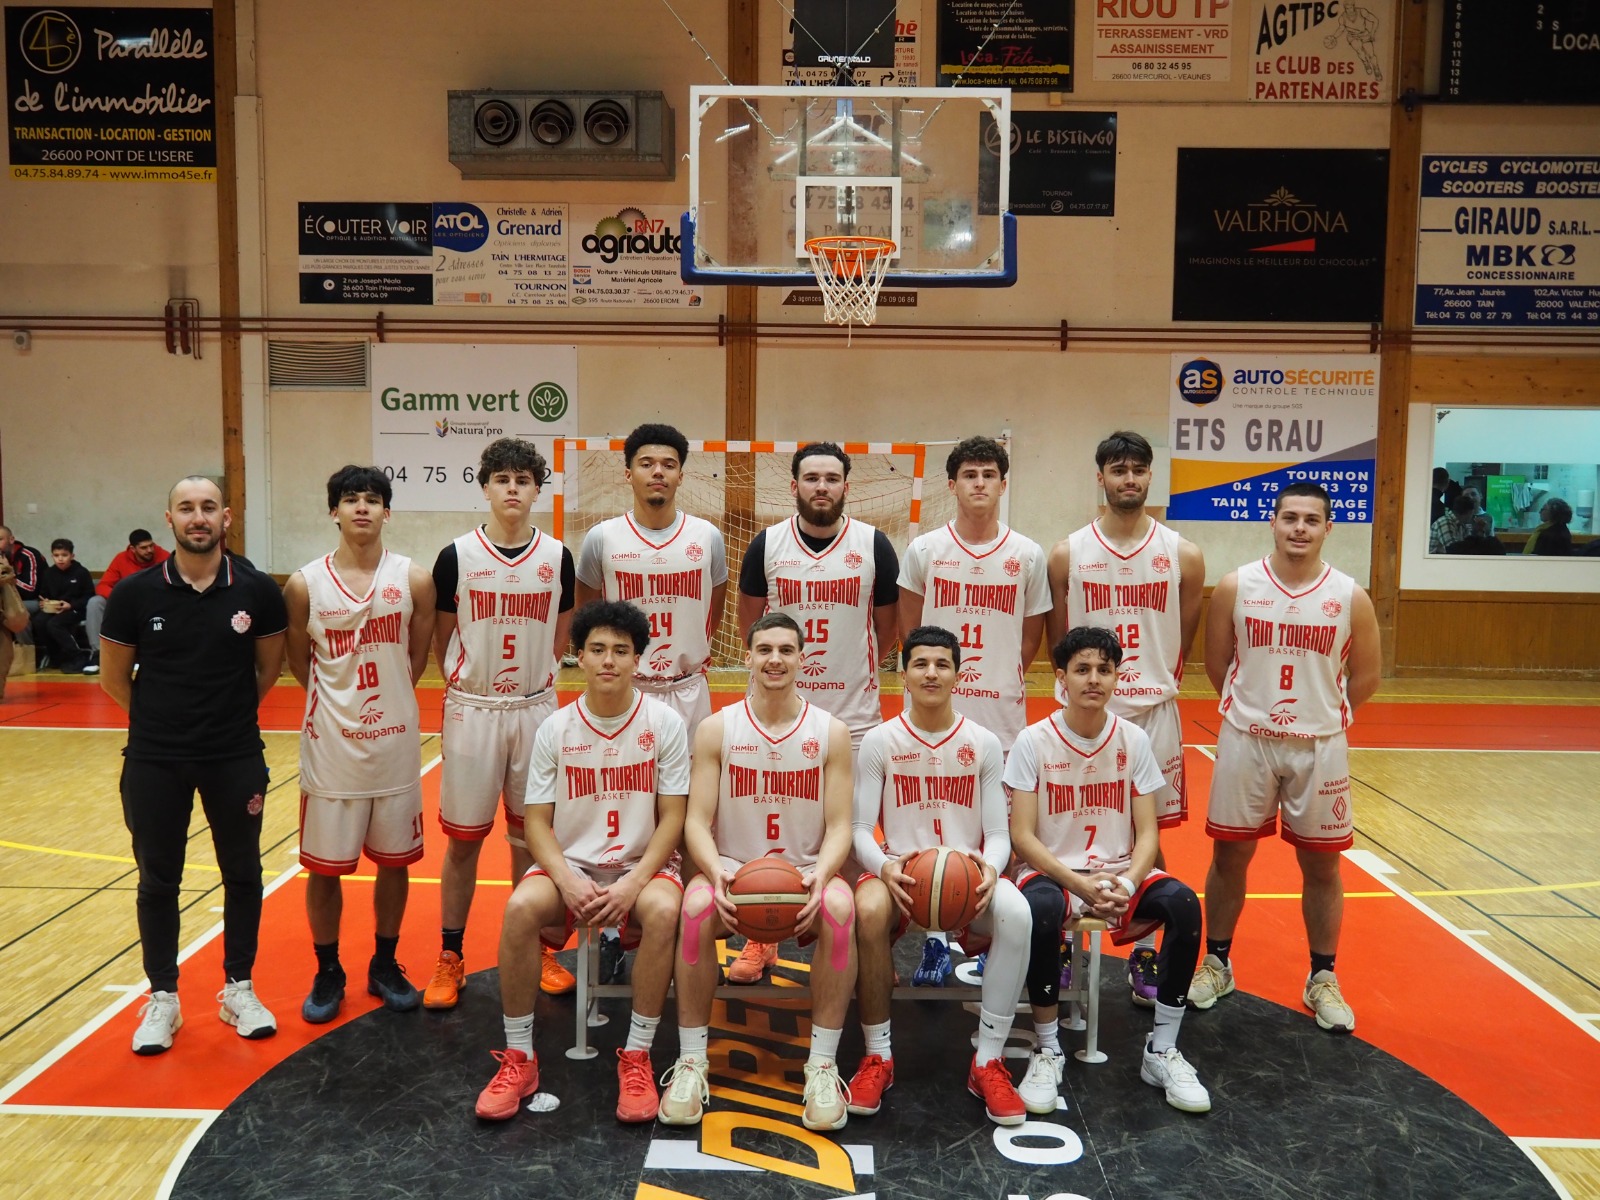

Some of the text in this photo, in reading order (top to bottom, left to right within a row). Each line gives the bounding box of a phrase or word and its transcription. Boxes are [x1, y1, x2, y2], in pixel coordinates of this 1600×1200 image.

[1097, 0, 1177, 19] RIOU
[1097, 29, 1229, 39] TERRASSEMENT VRD
[1256, 1, 1339, 56] AGTTBC
[94, 28, 208, 60] Parallèle
[1110, 44, 1215, 54] ASSAINISSEMENT
[1452, 40, 1462, 48] 10
[1132, 62, 1142, 70] 06
[1145, 62, 1154, 70] 80
[1256, 55, 1354, 75] LE CLUB DES
[1451, 59, 1461, 67] 12
[1450, 78, 1459, 86] 14
[14, 79, 211, 115] de l'immobilier
[1255, 81, 1380, 100] PARTENAIRES
[1449, 87, 1459, 95] 15
[14, 126, 212, 142] TRANSACTION LOCATION GESTION
[1026, 130, 1042, 144] LE
[41, 149, 195, 163] 26600 PONT DE L'ISERE
[1429, 160, 1489, 174] CYCLES
[14, 168, 213, 181] 04.75.84.89.74 www.immo45e.fr
[1442, 181, 1525, 194] SCOOTERS
[386, 218, 427, 236] VOIR
[435, 211, 484, 232] ATOL
[496, 219, 562, 236] Grenard
[634, 219, 665, 234] RN7
[1214, 209, 1349, 233] VALRHONA
[1455, 206, 1541, 235] GIRAUD
[491, 253, 510, 261] TAIN
[1189, 257, 1241, 265] IMAGINONS
[1244, 257, 1254, 265] LE
[1257, 257, 1301, 266] MEILLEUR
[1303, 258, 1316, 266] DU
[1466, 244, 1537, 267] MBK
[435, 254, 447, 272] 2
[1467, 270, 1575, 281] CONCESSIONNAIRE
[514, 282, 567, 291] TOURNON
[1443, 300, 1472, 308] 26600
[1476, 300, 1495, 308] TAIN
[1232, 387, 1375, 396] CONTROLE TECHNIQUE
[381, 387, 520, 412] Gamm vert
[1175, 418, 1323, 452] ETS GRAU
[423, 466, 447, 483] 75
[1287, 470, 1369, 481] TOURNON
[1233, 482, 1369, 493] 04 75 79
[1211, 497, 1248, 508] TAIN
[1230, 510, 1367, 521] 04 99
[641, 597, 678, 605] BASKET
[799, 603, 836, 611] BASKET
[955, 607, 992, 616] BASKET
[493, 618, 529, 626] BASKET
[649, 612, 672, 637] 14
[805, 619, 829, 643] 15
[960, 623, 984, 649] 11
[1115, 624, 1139, 649] 12
[502, 634, 516, 660] 5
[1268, 647, 1308, 658] BASKET
[357, 661, 379, 691] 10
[1280, 664, 1294, 691] 8
[341, 724, 407, 741] Groupama
[1323, 776, 1349, 788] GARAGE
[594, 792, 632, 802] BASKET
[753, 796, 792, 805] BASKET
[1073, 808, 1108, 819] BASKET
[607, 810, 620, 838] 9
[766, 813, 780, 840] 6
[1084, 825, 1097, 852] 7
